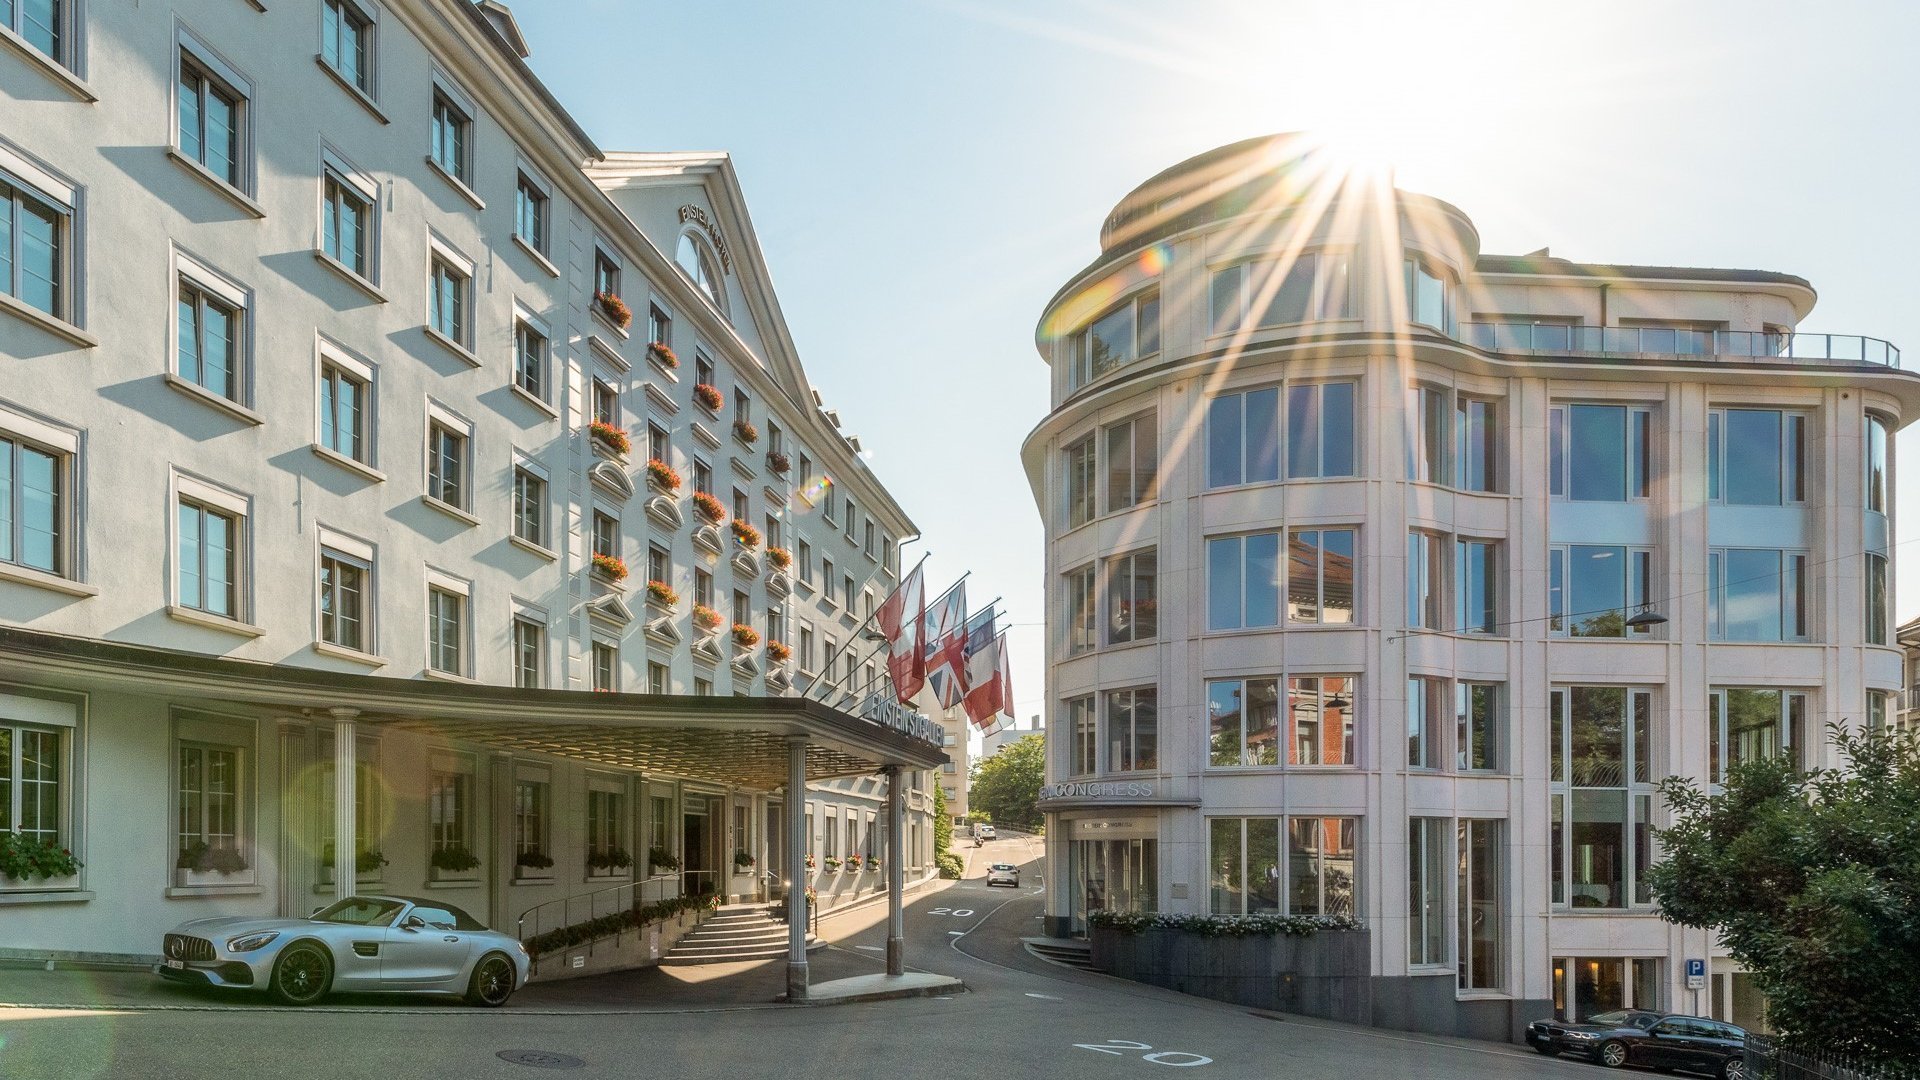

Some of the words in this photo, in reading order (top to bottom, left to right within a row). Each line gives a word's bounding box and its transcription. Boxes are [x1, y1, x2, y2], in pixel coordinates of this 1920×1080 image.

[871, 694, 909, 733] EINSTEIN
[1055, 782, 1153, 798] CONGRESS
[927, 907, 974, 917] 20
[1692, 961, 1701, 974] P
[1072, 1039, 1214, 1067] 20
